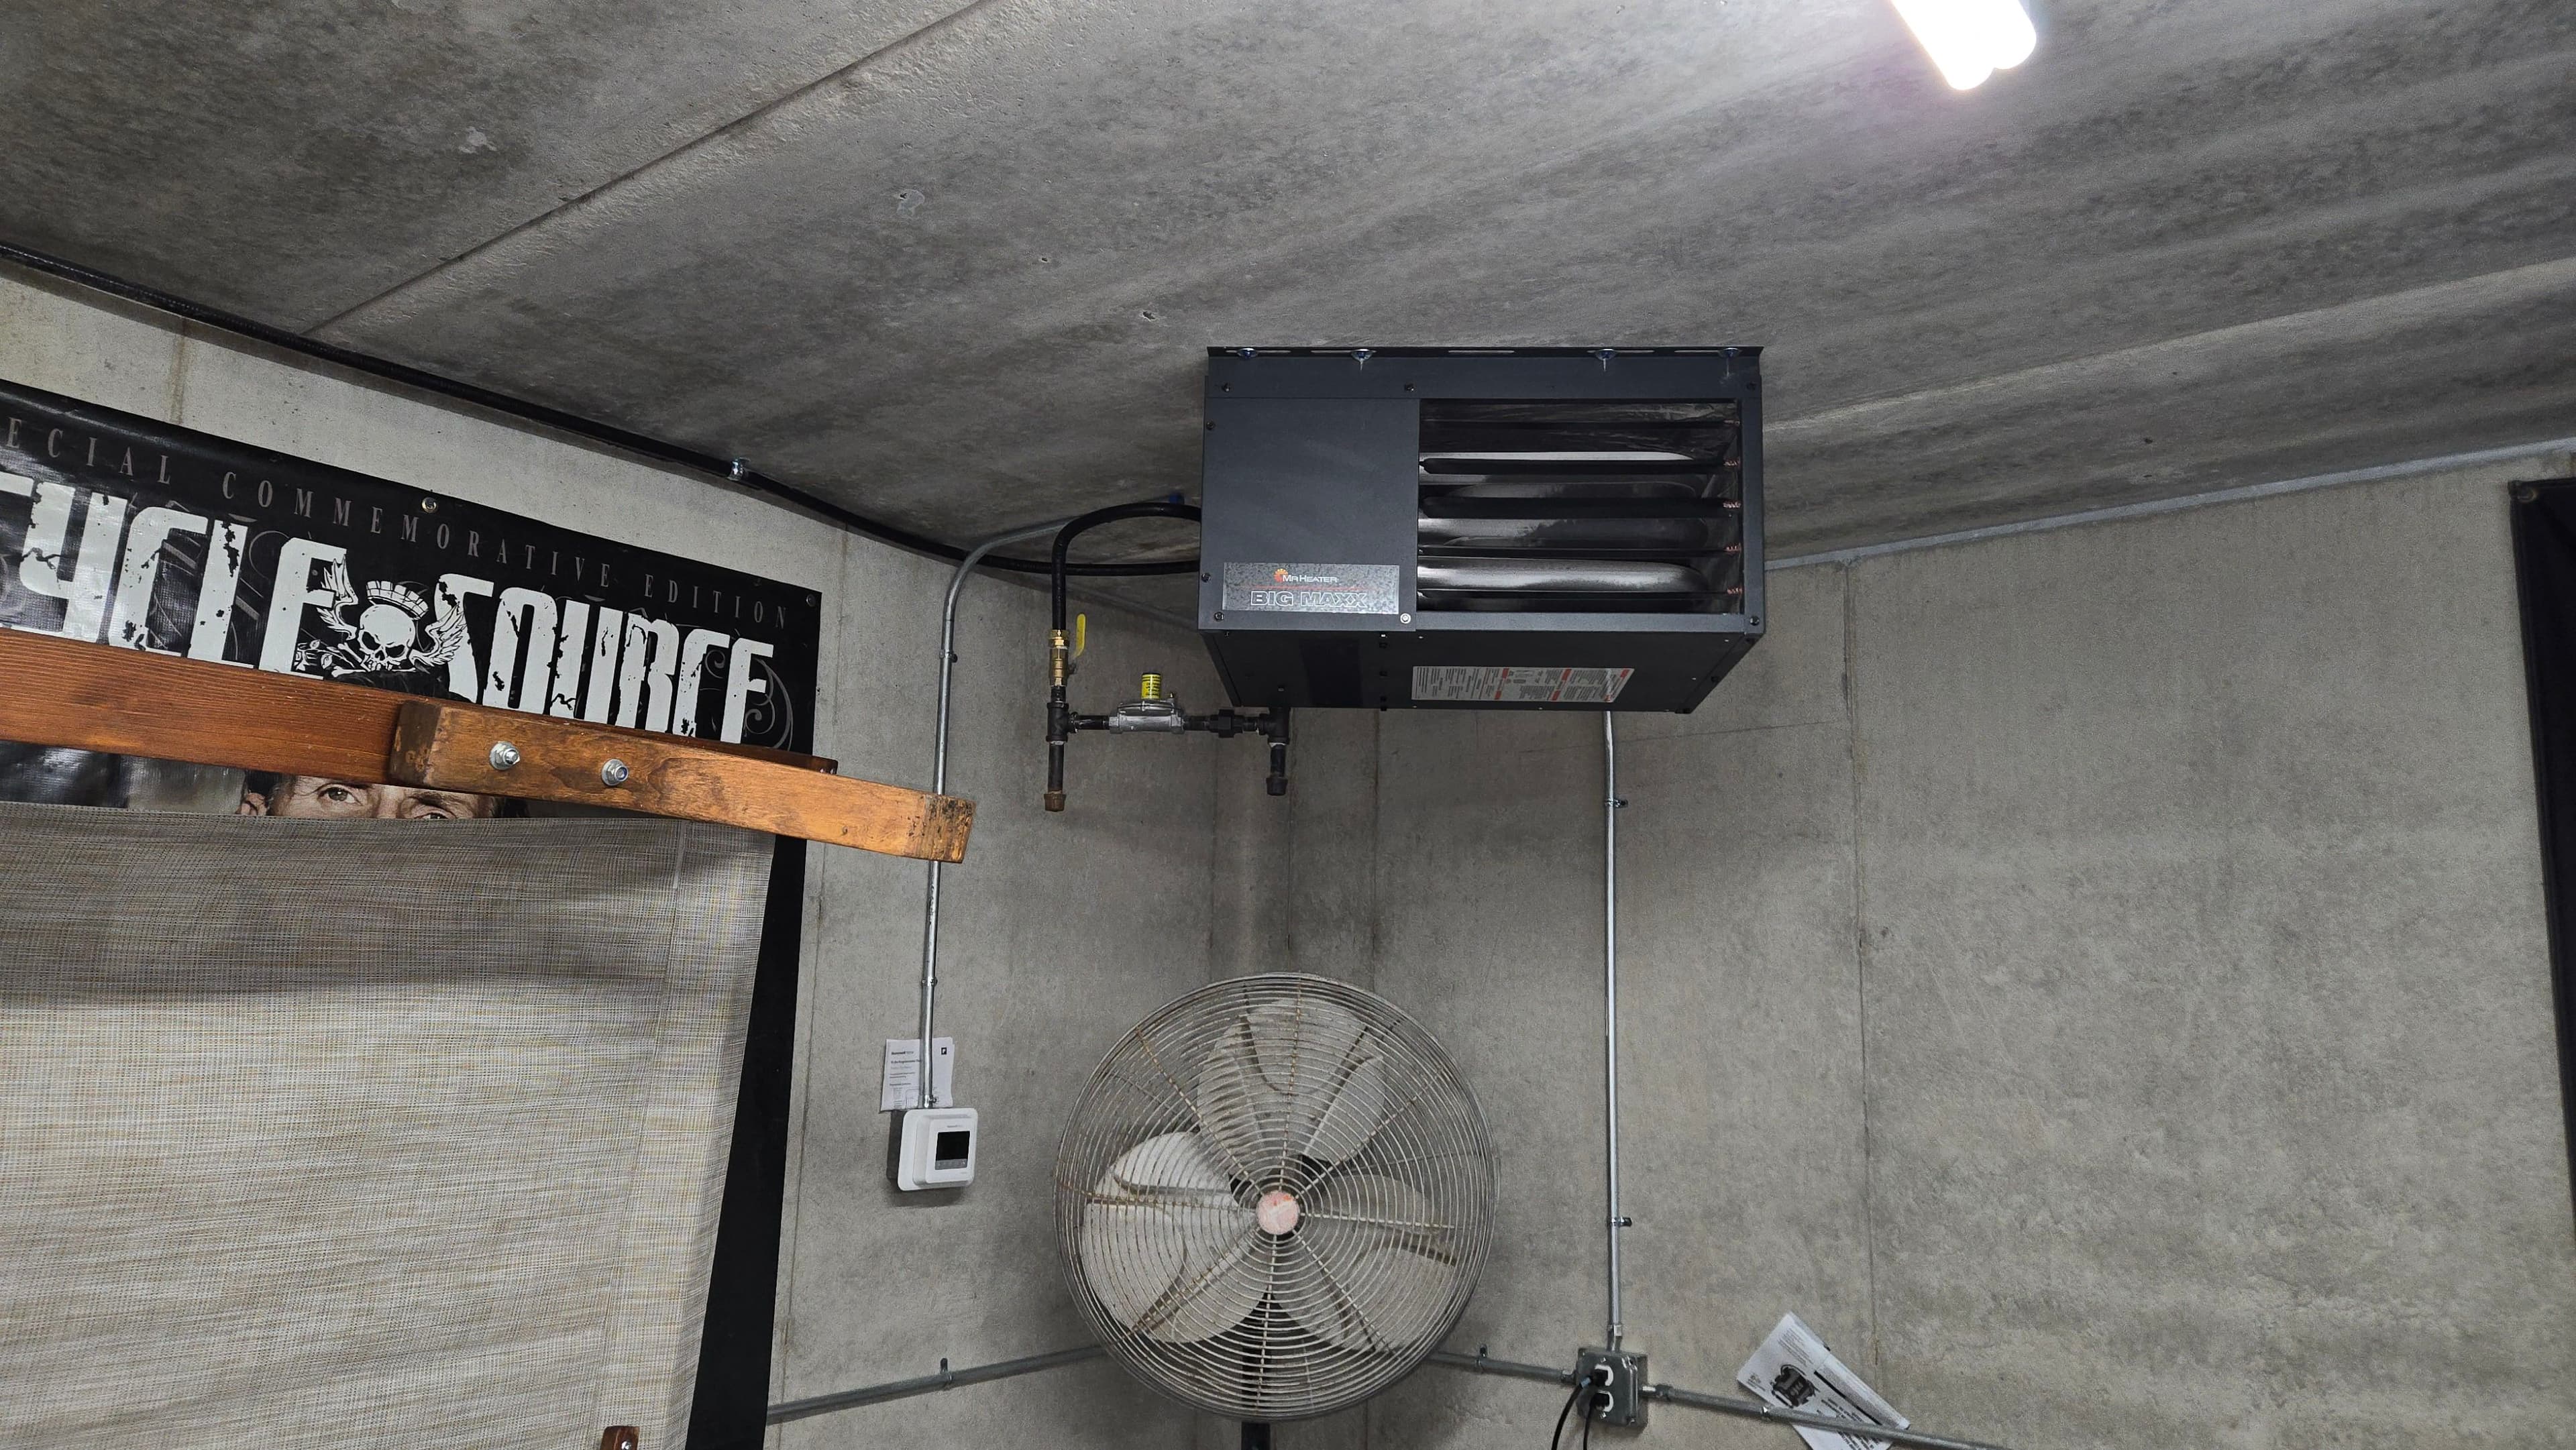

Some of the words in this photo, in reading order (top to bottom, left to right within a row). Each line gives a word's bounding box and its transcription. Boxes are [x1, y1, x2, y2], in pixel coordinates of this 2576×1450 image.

[222, 471, 610, 588] COMMEMORATIVE
[644, 573, 788, 630] EDITION
[1251, 591, 1294, 606] BIG
[1300, 592, 1368, 608] MAXX
[433, 573, 774, 744] SOURCE
